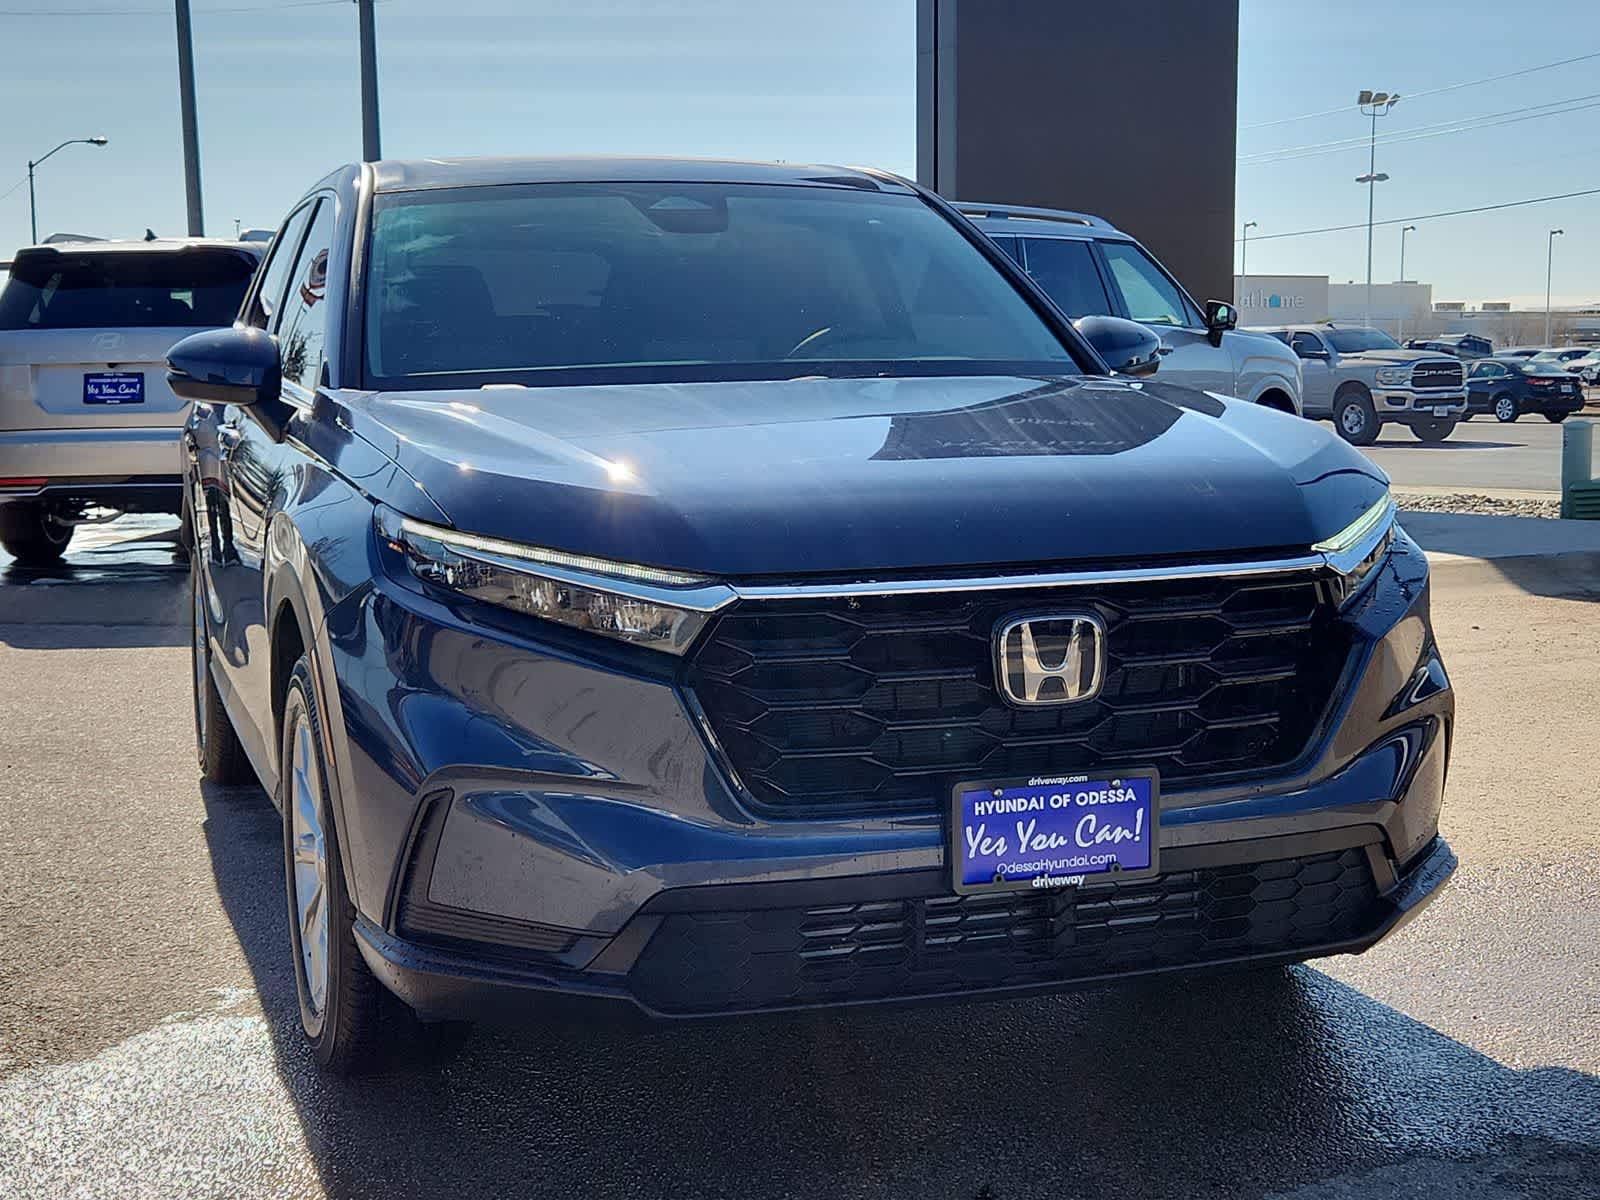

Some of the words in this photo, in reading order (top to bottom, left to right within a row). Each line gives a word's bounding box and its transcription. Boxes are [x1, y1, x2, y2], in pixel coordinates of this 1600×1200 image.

[102, 384, 117, 395] You
[119, 383, 140, 394] Can!
[1028, 775, 1088, 786] driveway.com
[974, 796, 1044, 816] HYUNDAI
[1049, 793, 1071, 809] OF
[1075, 787, 1137, 806] ODESSA
[965, 823, 1007, 859] Yes
[1016, 818, 1068, 854] You
[1075, 807, 1144, 848] Can!
[996, 853, 1117, 875] OdessaHyundai.com
[1032, 873, 1085, 889] driveway
